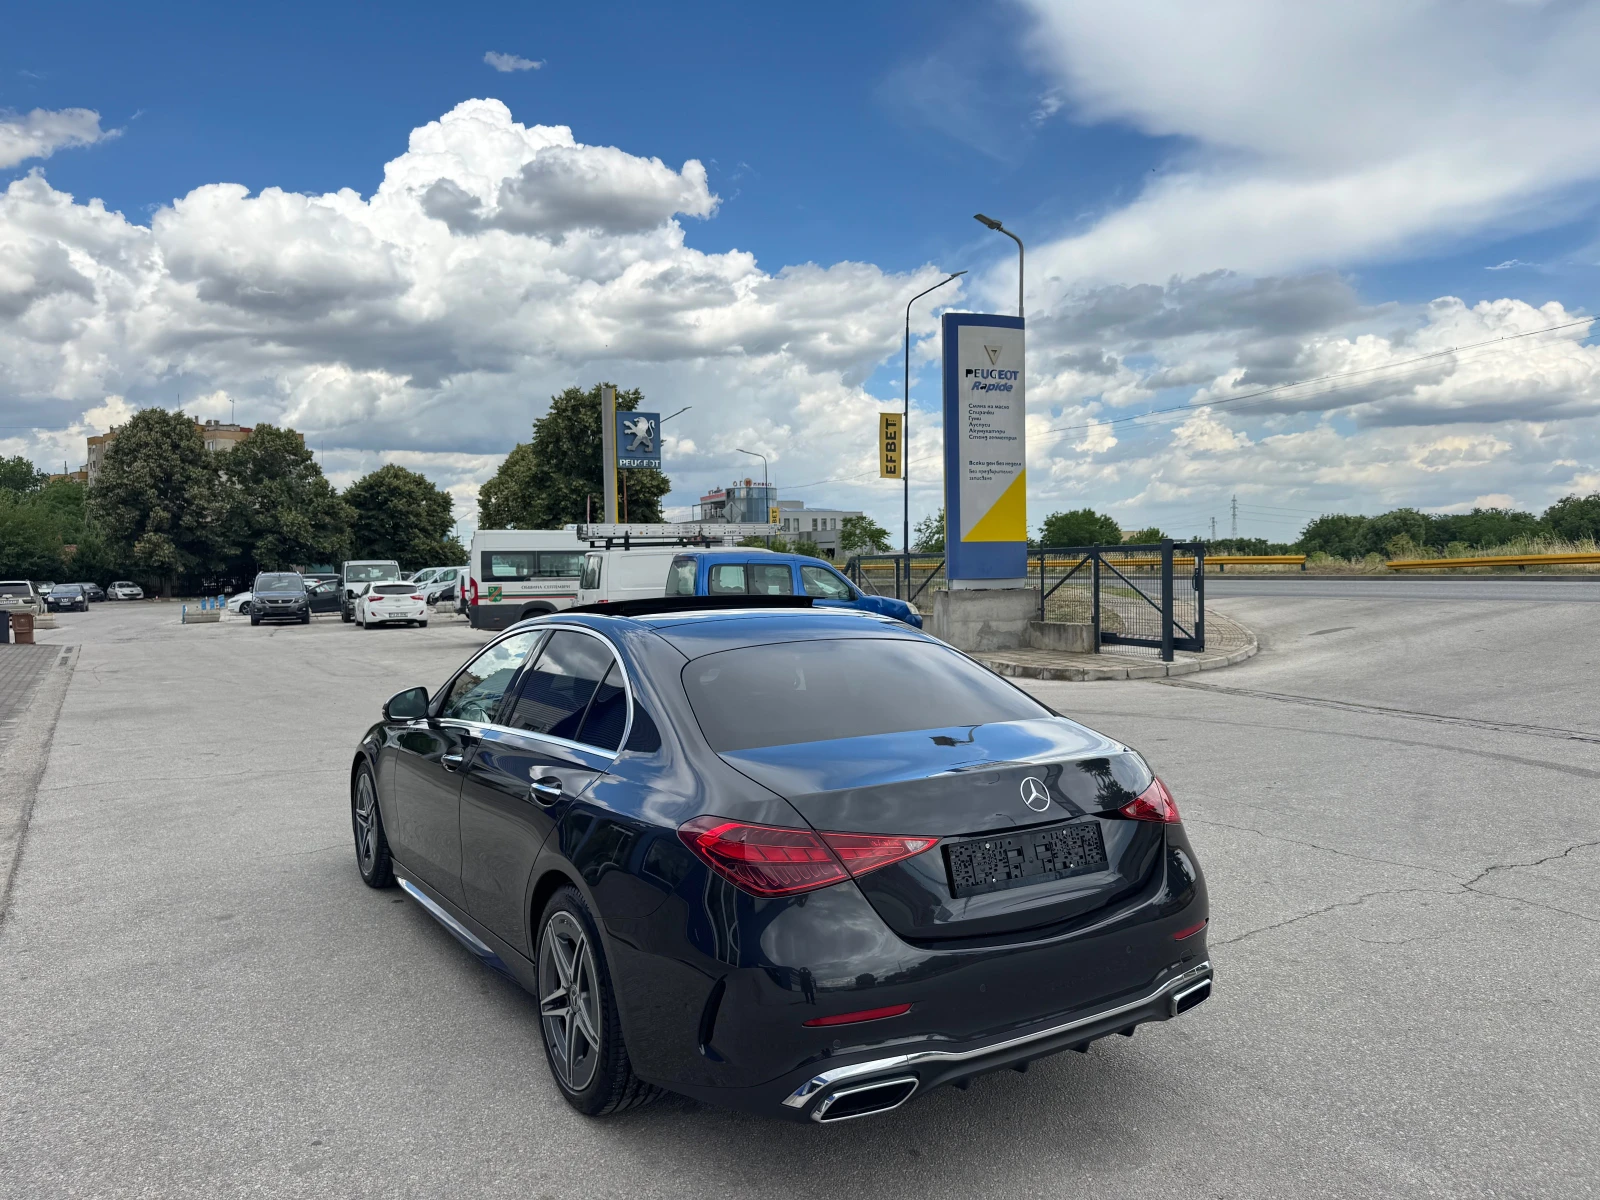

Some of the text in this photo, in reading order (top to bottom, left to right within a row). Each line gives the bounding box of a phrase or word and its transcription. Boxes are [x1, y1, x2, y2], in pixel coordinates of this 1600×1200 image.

[965, 368, 1020, 380] PEUGEOT
[971, 381, 1013, 393] Rapide
[885, 417, 897, 474] EFBET
[619, 459, 660, 467] PEUGEOT
